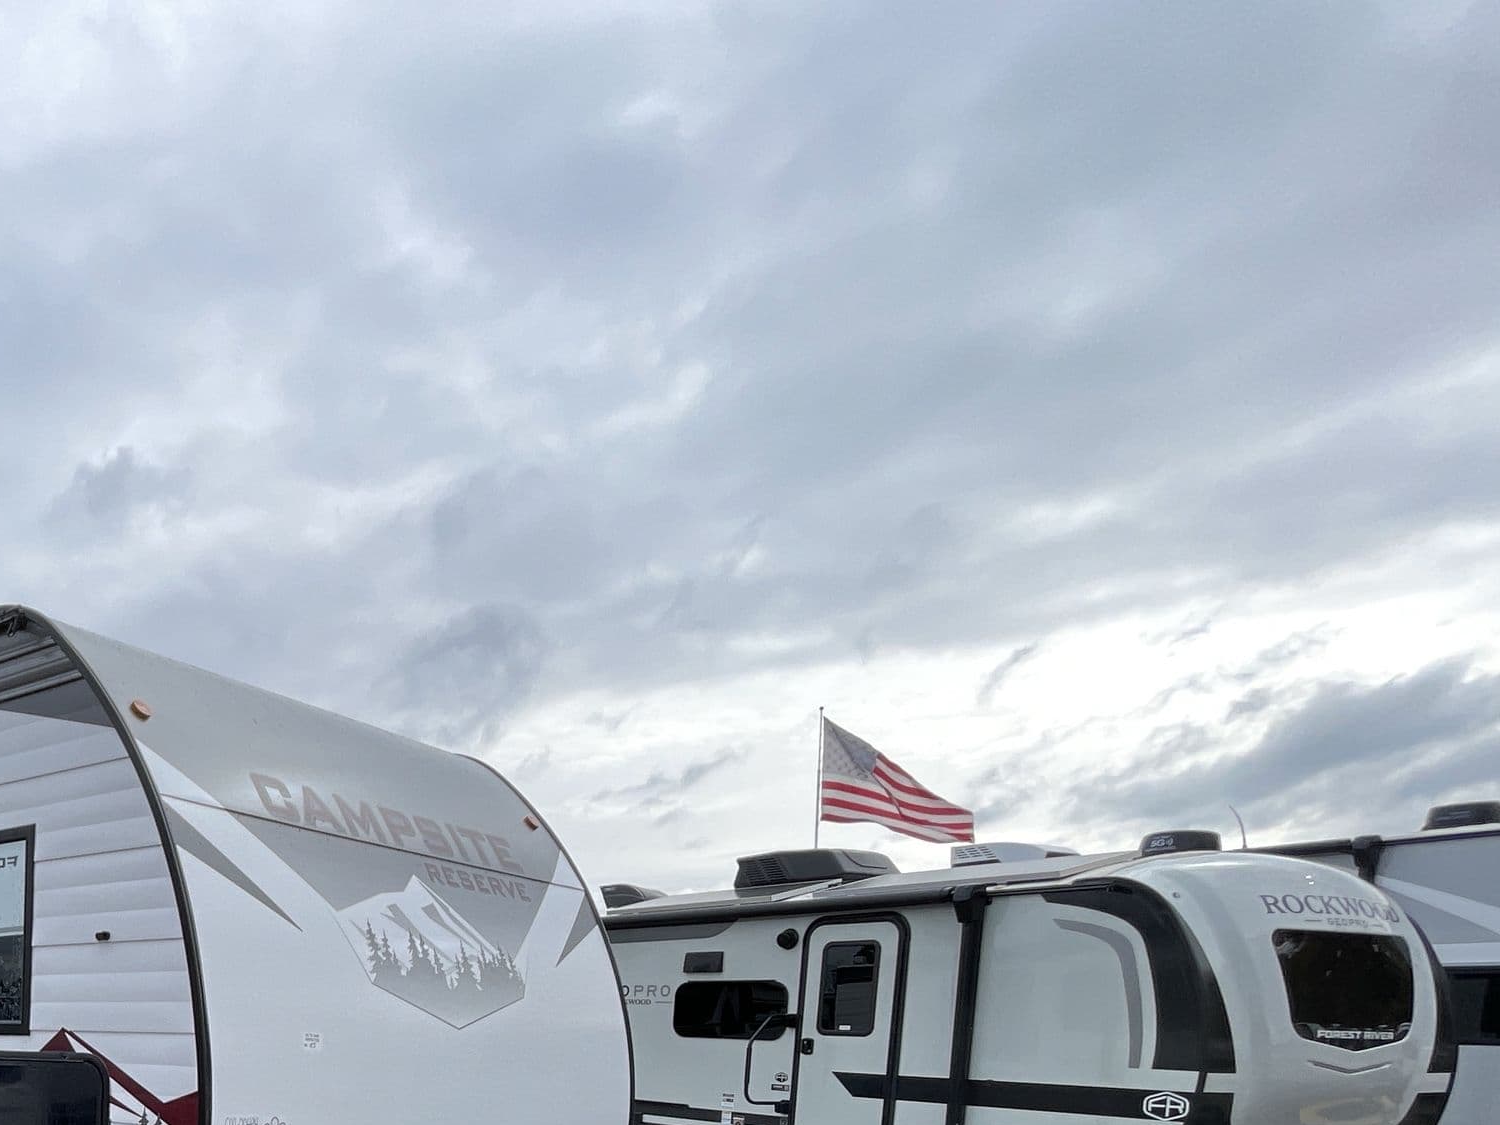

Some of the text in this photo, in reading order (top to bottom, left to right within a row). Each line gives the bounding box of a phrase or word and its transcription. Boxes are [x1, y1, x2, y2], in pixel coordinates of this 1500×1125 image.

[250, 772, 525, 874] CAMPSITE
[423, 862, 532, 902] RESERVE
[1260, 894, 1400, 923] ROCKWOOD
[1317, 1030, 1394, 1040] FOREST RIVER
